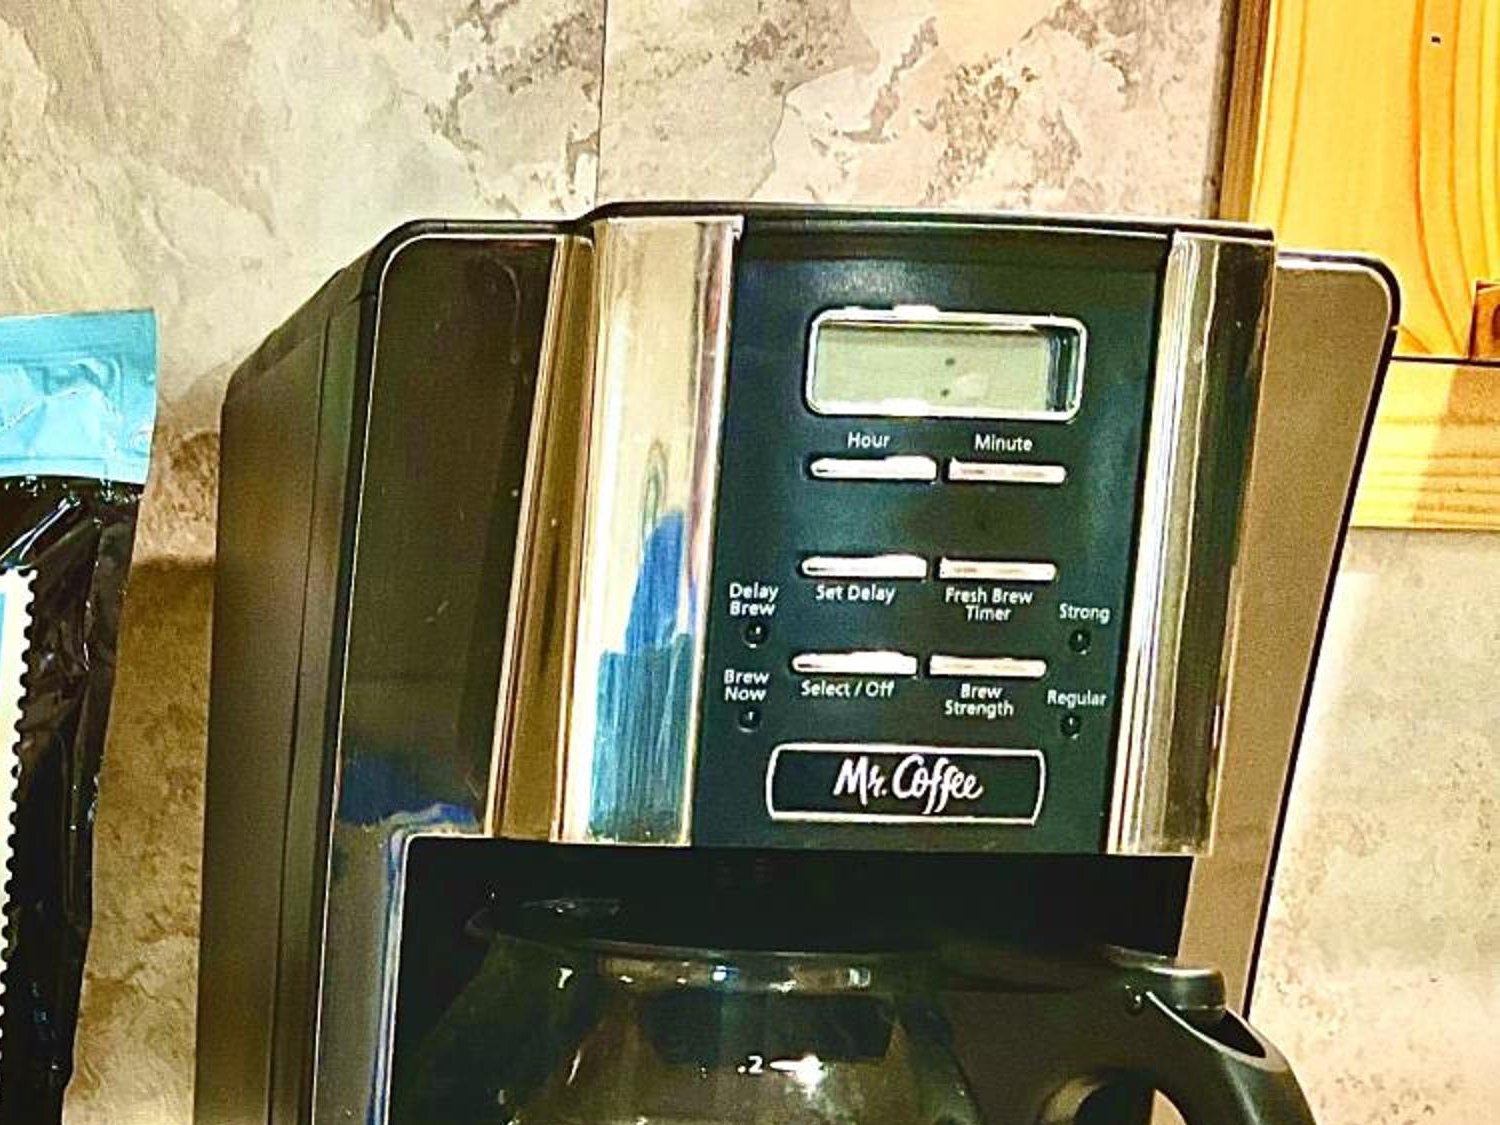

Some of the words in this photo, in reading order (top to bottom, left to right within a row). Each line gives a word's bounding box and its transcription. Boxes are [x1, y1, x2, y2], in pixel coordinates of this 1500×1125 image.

[847, 431, 891, 449] Hour
[974, 433, 1033, 451] Minute
[729, 582, 779, 602] Delay
[815, 584, 844, 601] Set
[848, 584, 896, 605] Delay
[945, 587, 987, 604] Fresh
[991, 588, 1033, 605] Brew
[729, 601, 776, 616] Brew
[965, 605, 1012, 622] Timer
[1059, 603, 1111, 625] Strong
[723, 669, 770, 684] Brew
[724, 687, 767, 702] Now
[801, 680, 850, 697] Select
[865, 680, 895, 698] Off
[960, 683, 1003, 699] Brew
[1047, 689, 1107, 709] Regular
[945, 699, 1014, 719] Strength
[833, 755, 887, 806] Mr.
[892, 753, 984, 815] Coffee
